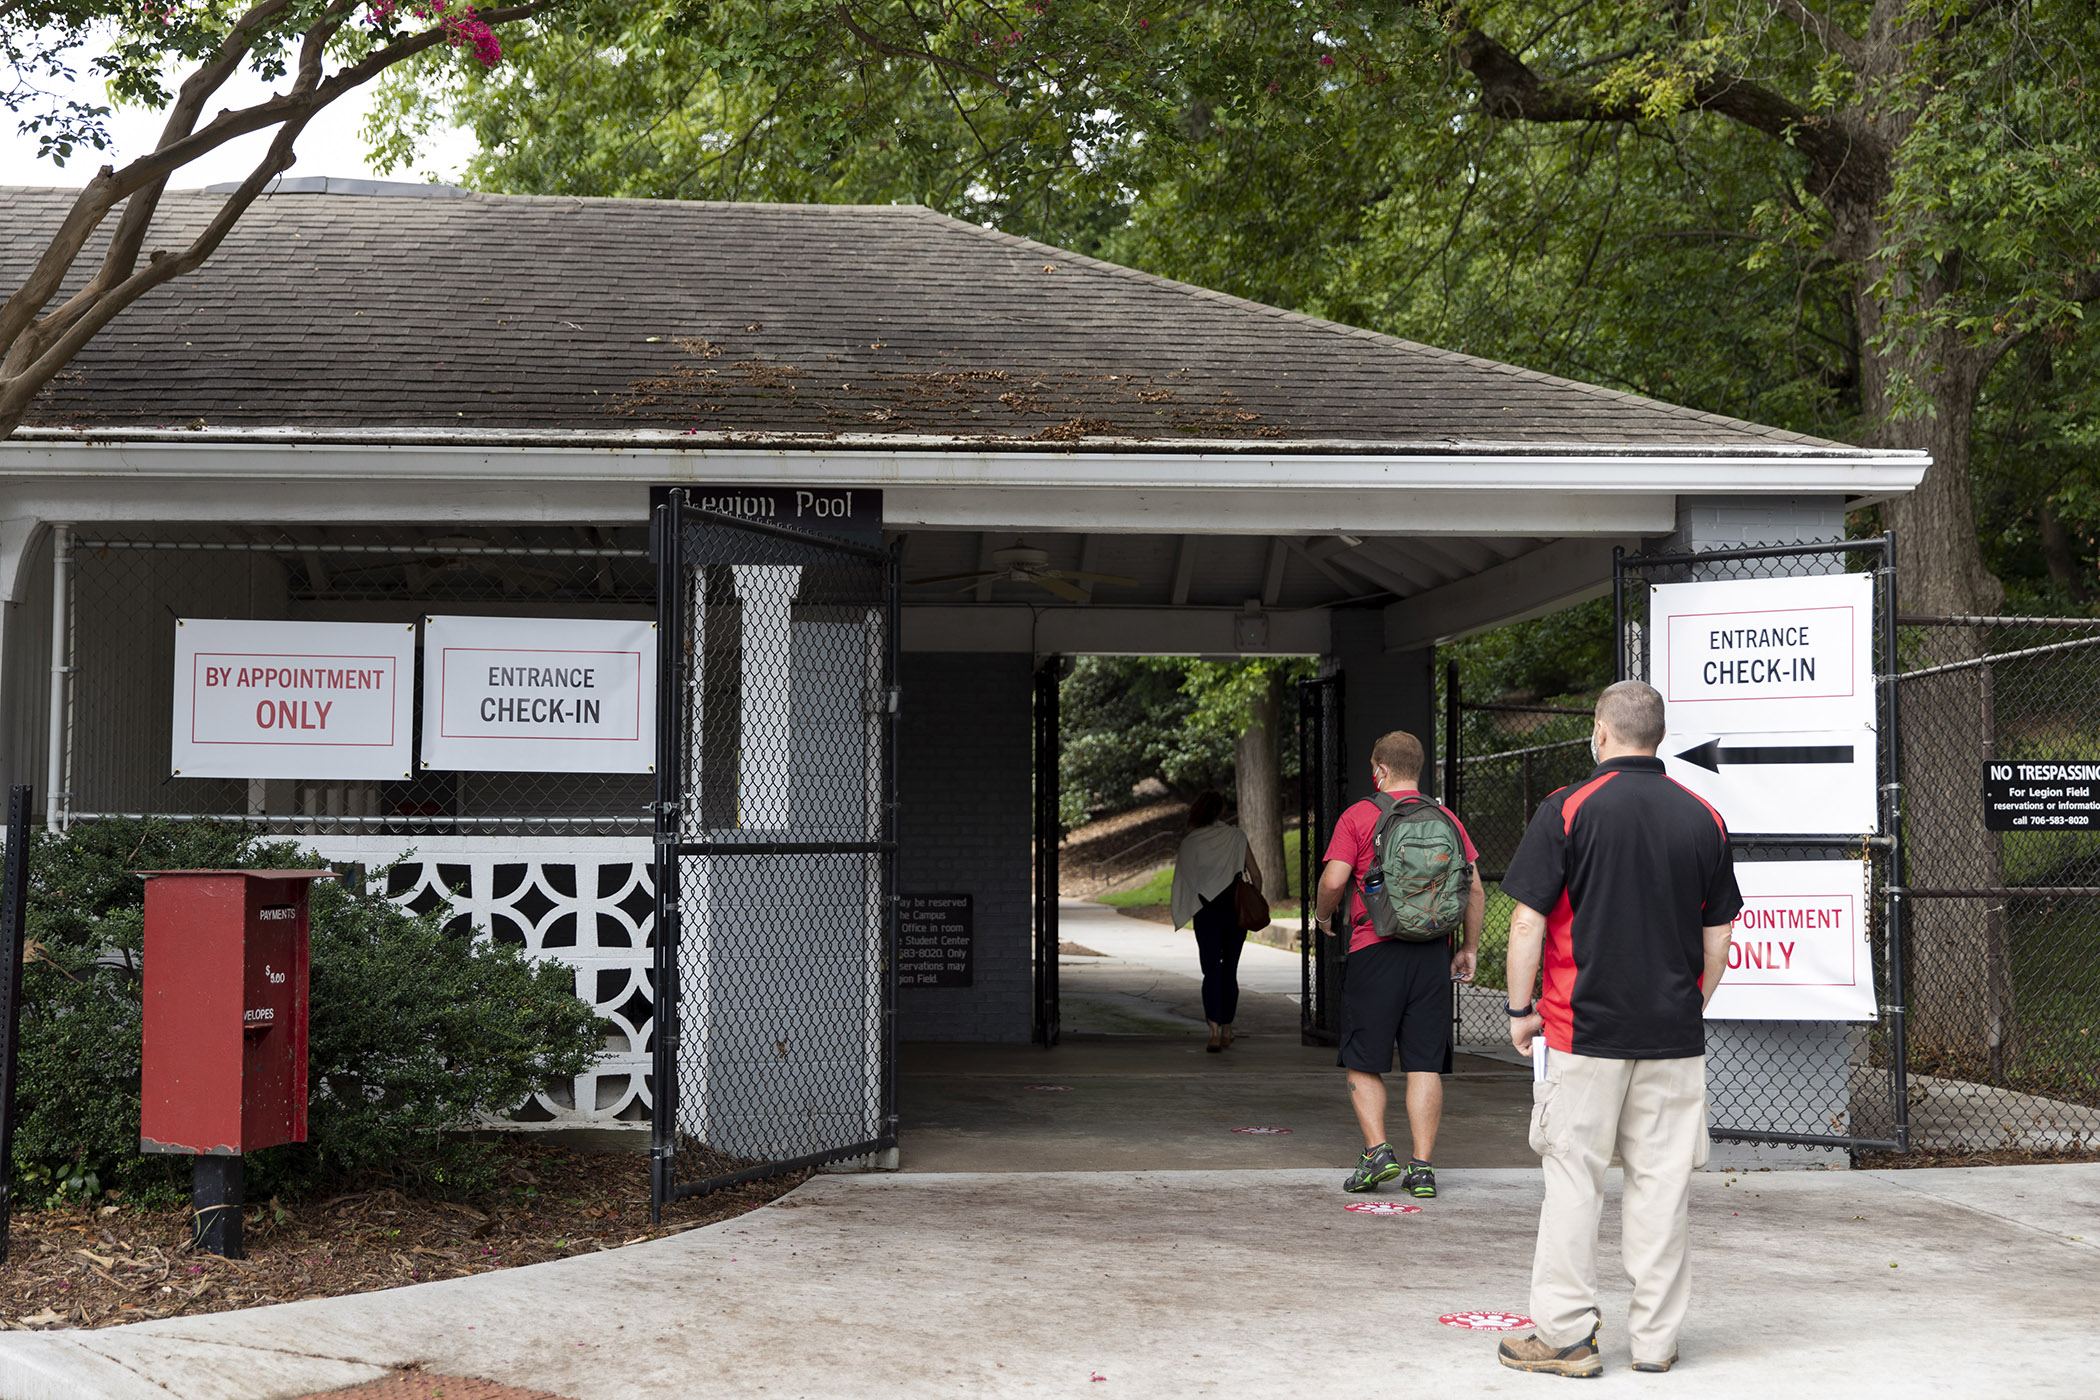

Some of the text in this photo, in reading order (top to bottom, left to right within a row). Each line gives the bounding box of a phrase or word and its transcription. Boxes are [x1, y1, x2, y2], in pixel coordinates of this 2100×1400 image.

[796, 490, 853, 518] Pool
[1709, 626, 1810, 650] ENTRANCE
[488, 666, 595, 689] ENTRANCE
[1703, 657, 1816, 685] CHECK-IN
[205, 667, 385, 690] BY APPOINTMENT
[255, 700, 333, 731] ONLY
[480, 697, 601, 724] CHECK-IN
[1990, 765, 2013, 781] NO
[2009, 787, 2090, 799] For Legion Field
[1993, 801, 2100, 810] reservations or informatio
[2012, 816, 2089, 825] call 706-583-8020
[900, 897, 967, 908] ay be reserved
[259, 908, 296, 921] PAYMENTS
[900, 910, 946, 921] he Campus
[1731, 908, 1843, 929] POINTMENT
[901, 923, 964, 933] Office in room
[905, 936, 938, 945] Student
[941, 936, 970, 945] Center
[947, 949, 967, 959] Only
[1726, 941, 1796, 970] ONLY
[899, 961, 966, 972] servations may
[244, 1008, 275, 1020] VELOPES
